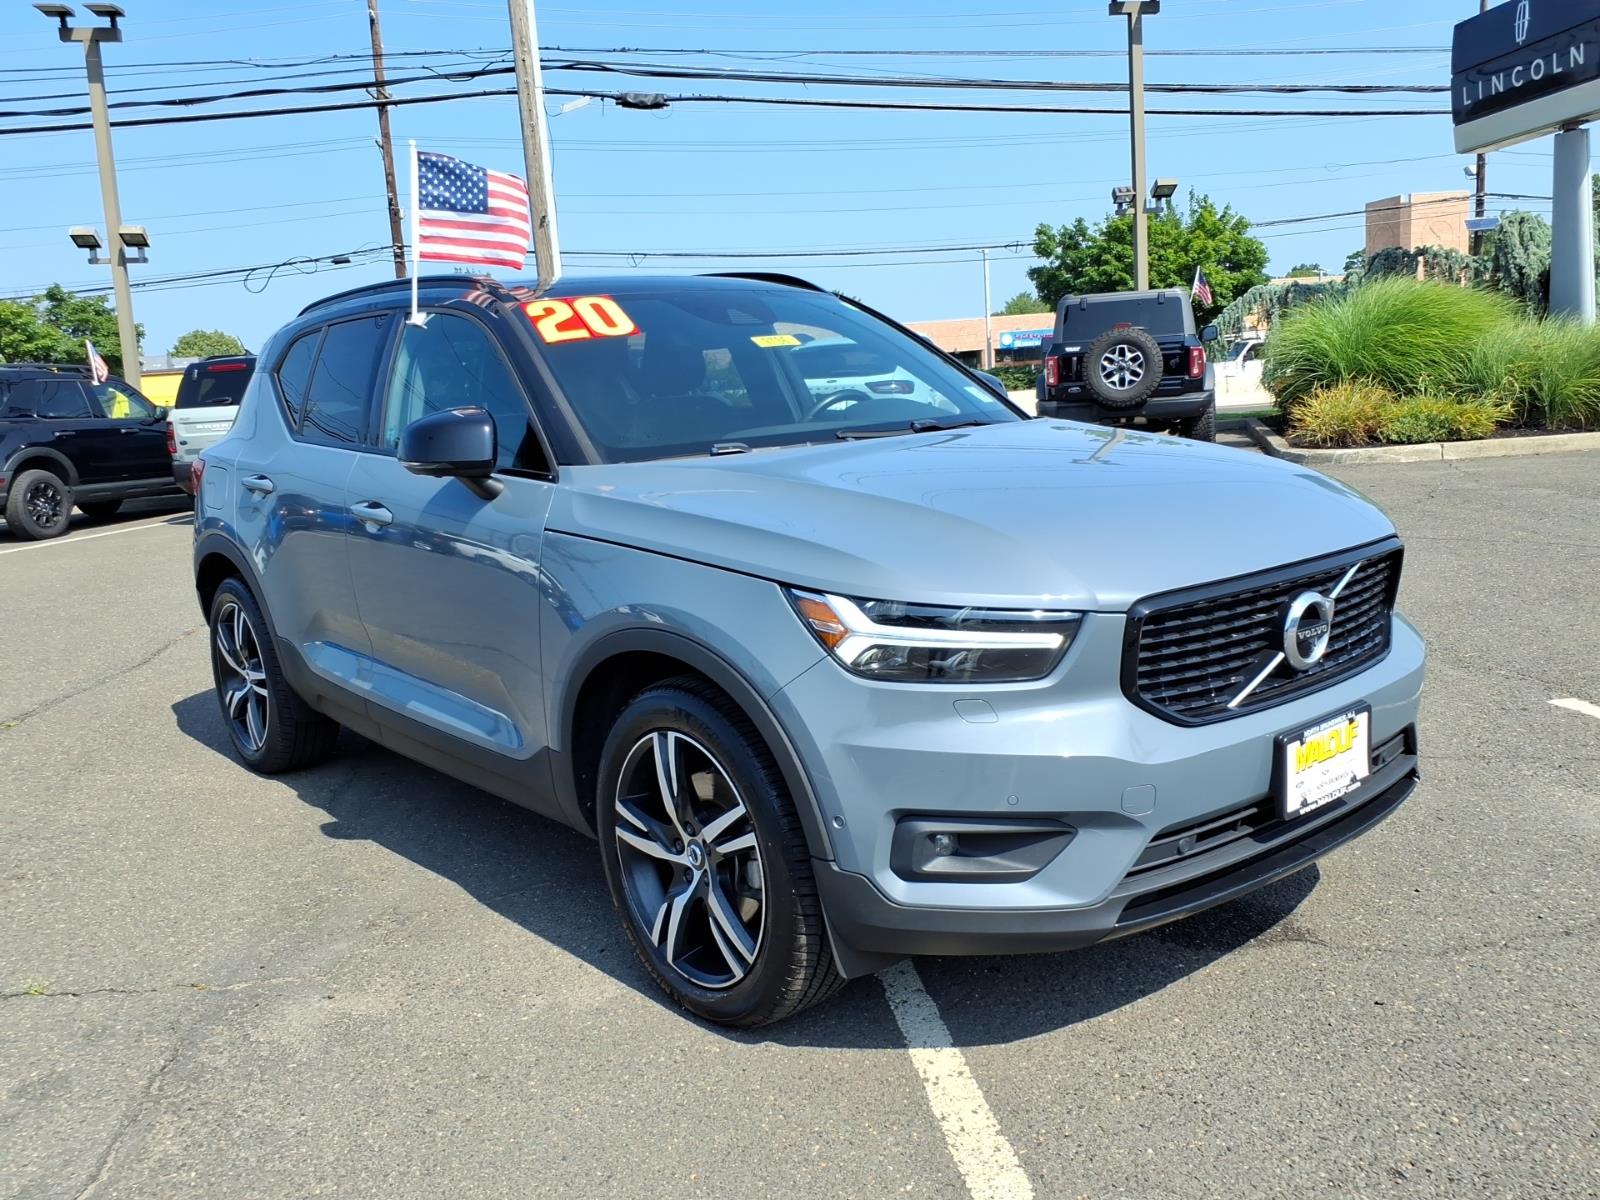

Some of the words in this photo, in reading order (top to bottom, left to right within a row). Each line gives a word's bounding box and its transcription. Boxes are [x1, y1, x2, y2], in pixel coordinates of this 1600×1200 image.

[1463, 43, 1584, 105] LINCOLN
[526, 296, 635, 343] 20
[1298, 624, 1328, 640] VOLVO
[1296, 721, 1358, 774] MALOUF
